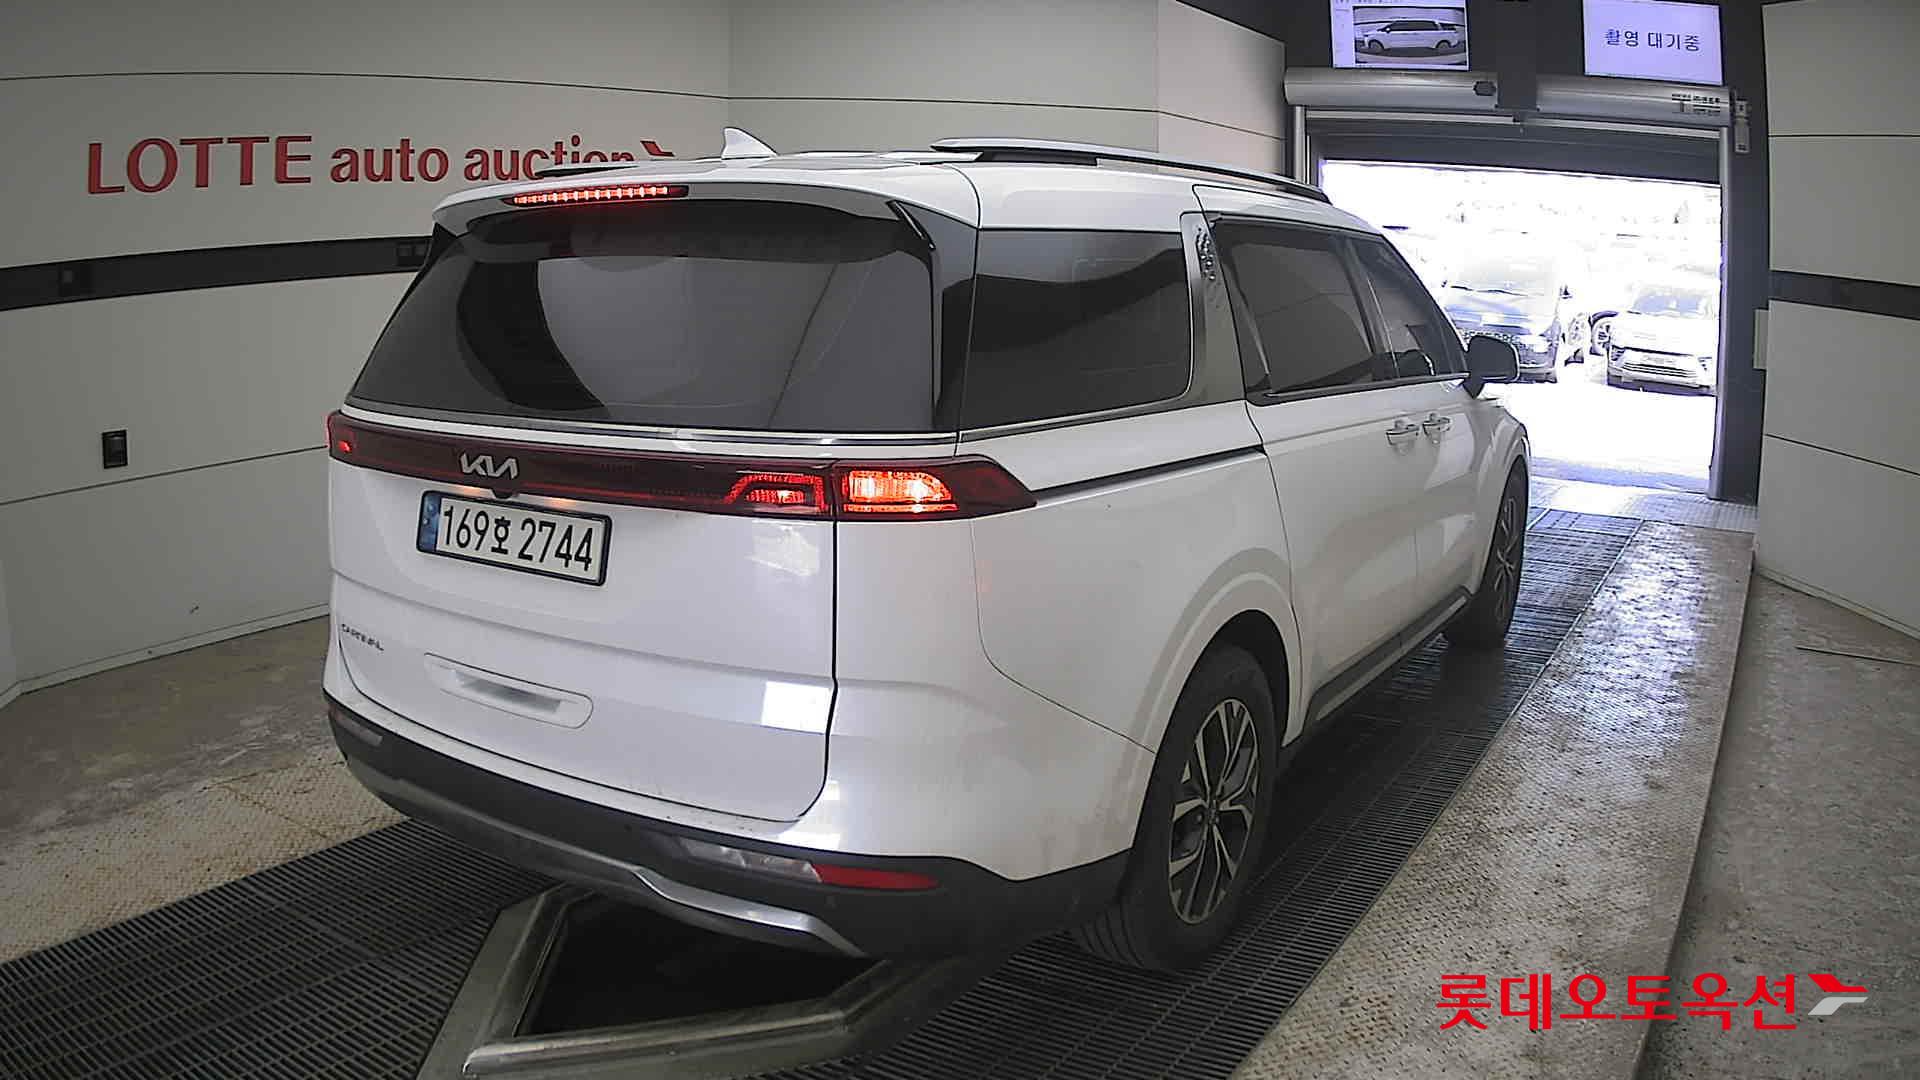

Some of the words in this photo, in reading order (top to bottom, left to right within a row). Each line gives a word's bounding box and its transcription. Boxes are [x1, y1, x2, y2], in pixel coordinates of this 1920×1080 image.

[1647, 32, 1700, 51] 대기중
[88, 135, 312, 194] LOTTE
[330, 138, 449, 183] auto
[459, 452, 519, 480] KIA
[443, 505, 511, 555] 169호
[518, 517, 593, 571] 2744
